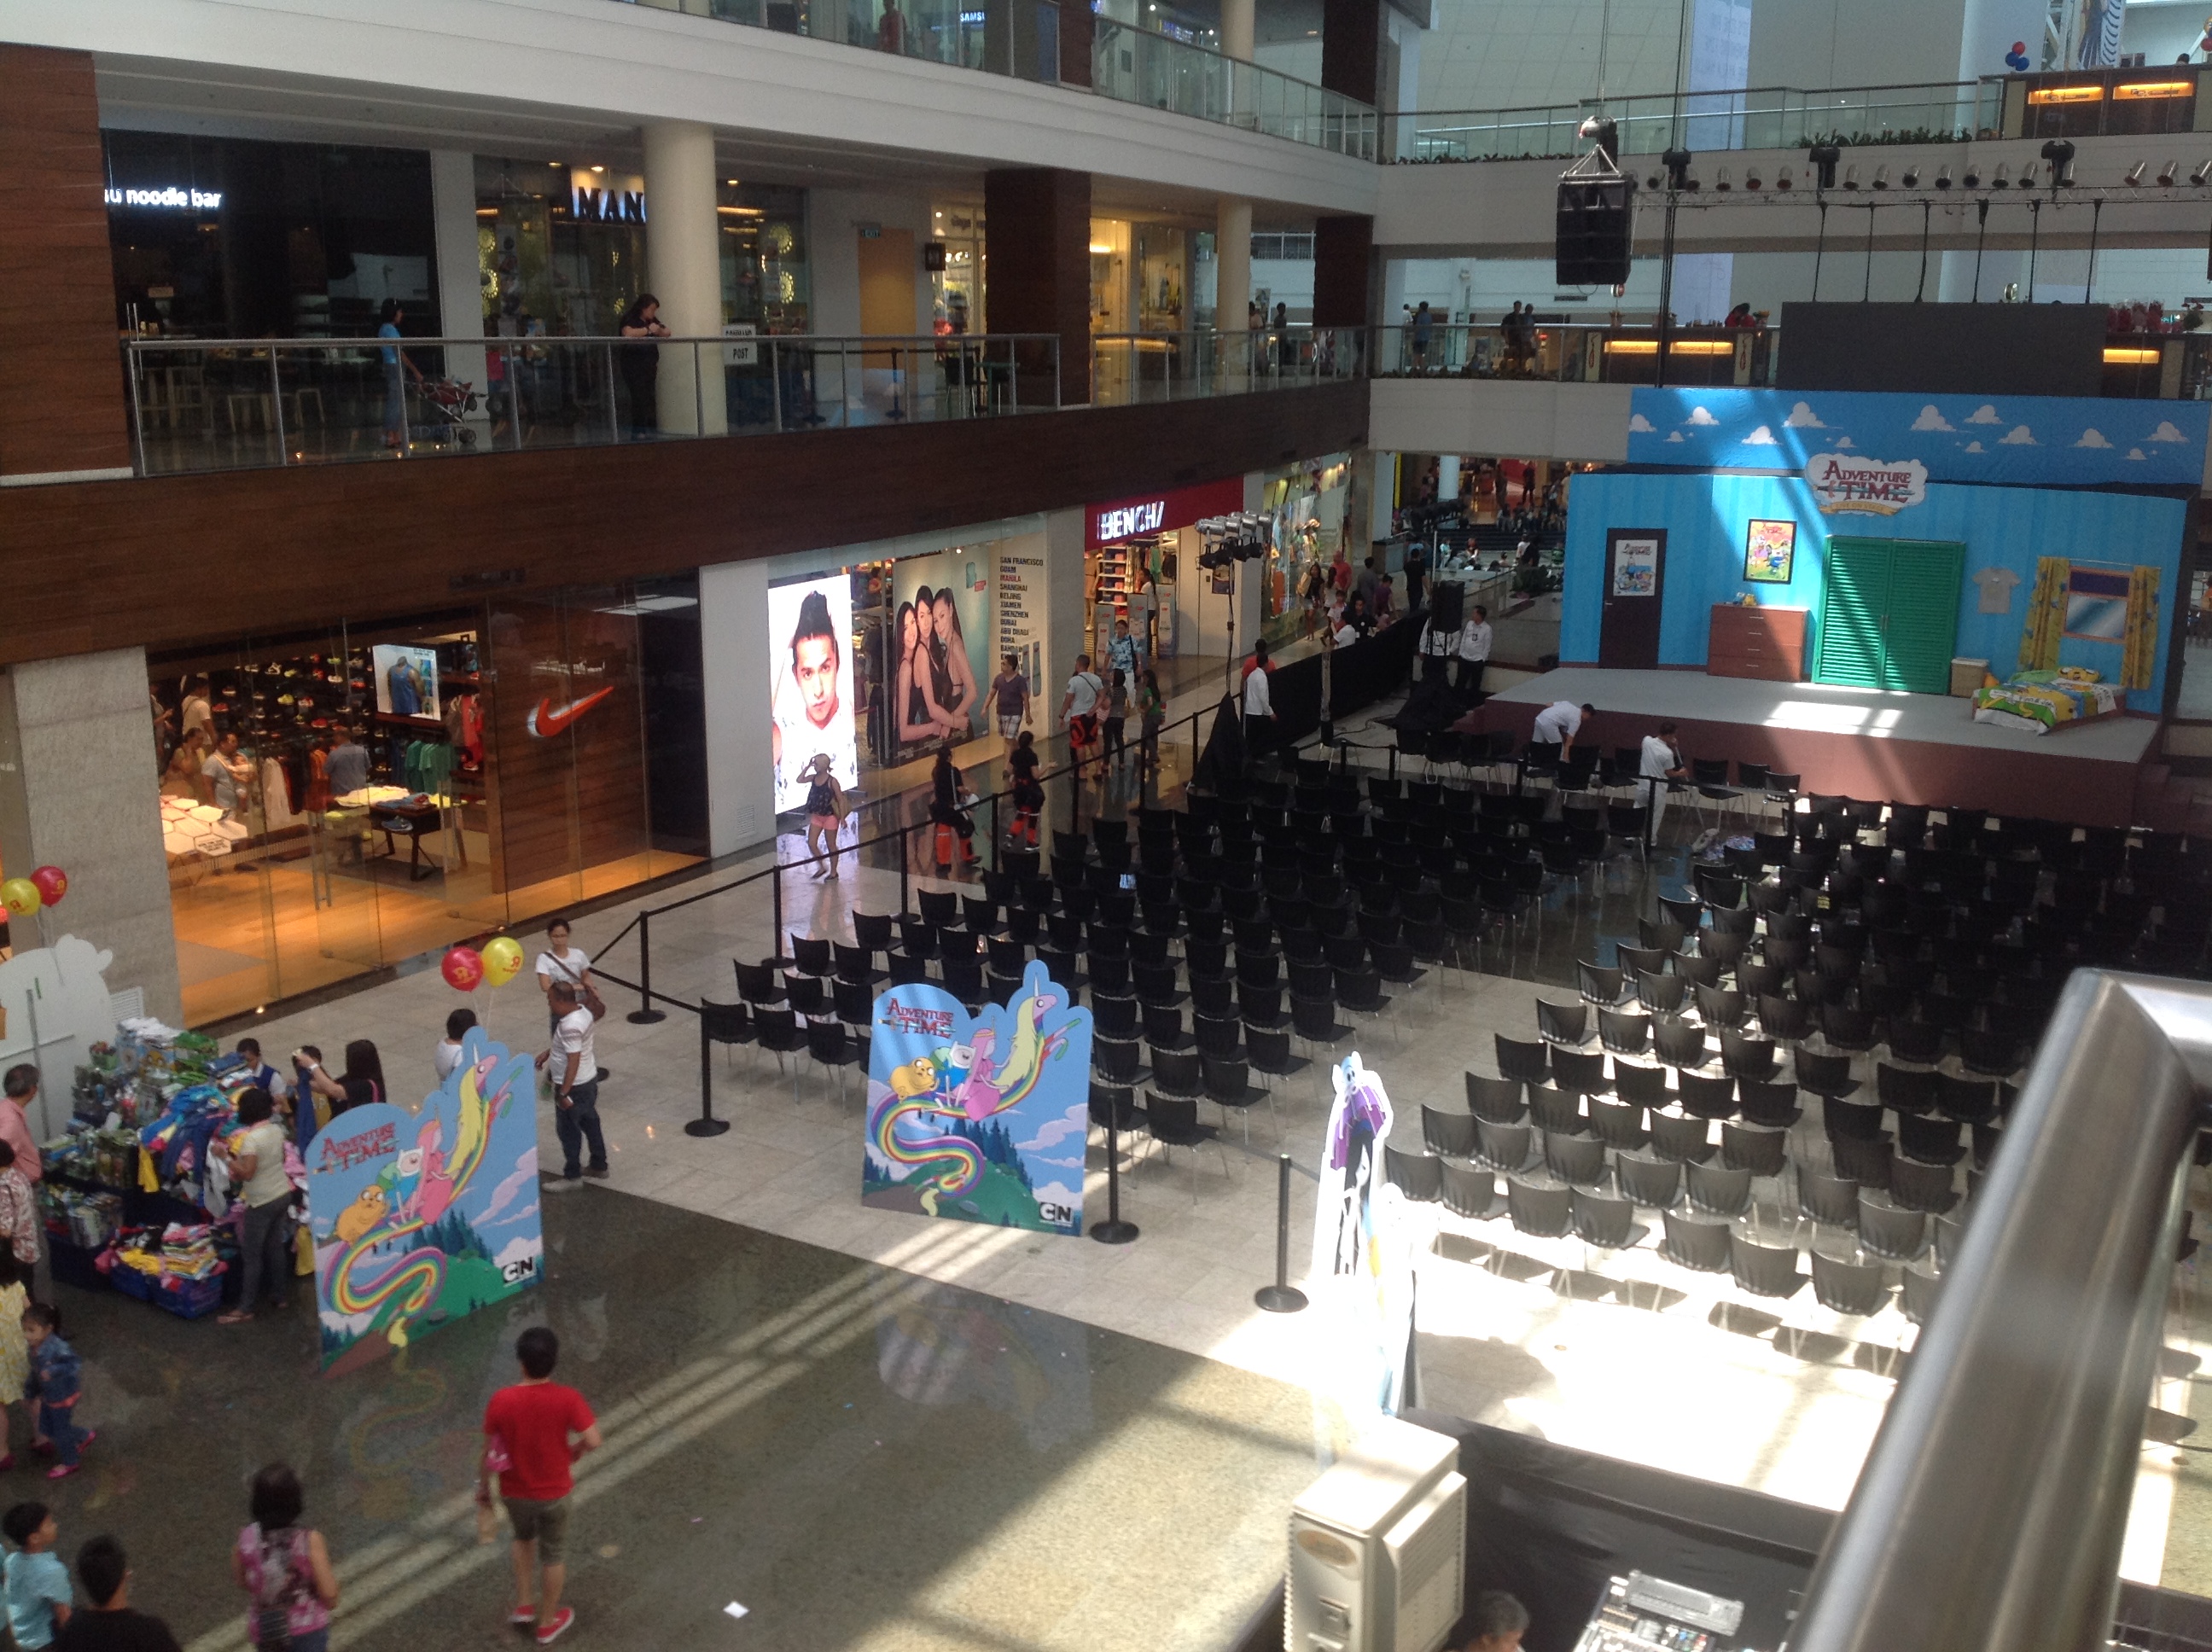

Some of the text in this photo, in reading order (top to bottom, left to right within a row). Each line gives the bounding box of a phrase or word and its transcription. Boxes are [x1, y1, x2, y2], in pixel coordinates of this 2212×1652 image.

[126, 187, 188, 206] noodle
[191, 189, 222, 207] bar
[578, 186, 647, 223] MAN
[1822, 460, 1912, 484] ADVENTURE
[1838, 480, 1909, 503] TIME
[1013, 557, 1043, 566] FRANCISCO
[886, 998, 954, 1022] ADVENTURE
[899, 1015, 952, 1039] TIME
[1039, 1202, 1072, 1223] CN
[503, 1256, 533, 1283] CN
